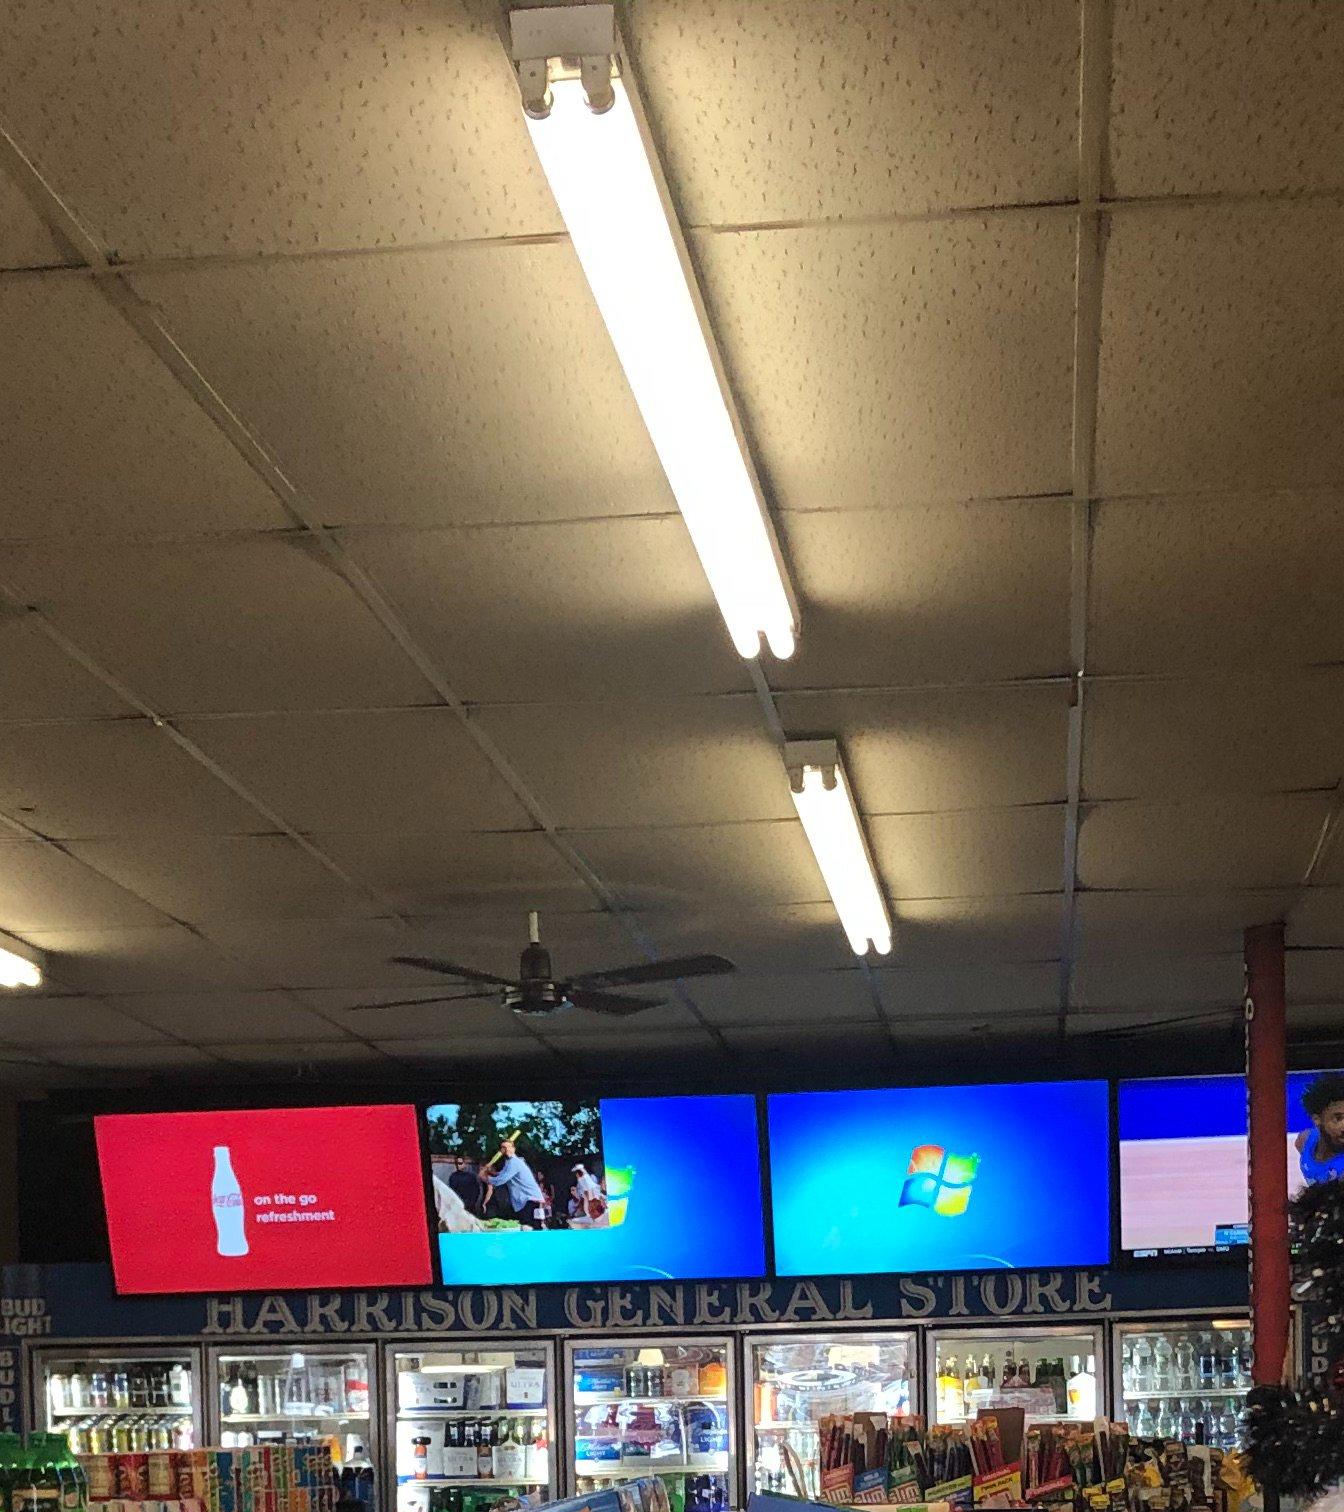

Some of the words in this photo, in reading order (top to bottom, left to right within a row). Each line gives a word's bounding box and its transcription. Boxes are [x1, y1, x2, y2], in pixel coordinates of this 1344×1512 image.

[254, 1195, 272, 1206] on
[274, 1193, 296, 1205] the
[299, 1194, 318, 1207] go
[256, 1210, 335, 1223] refreshment
[0, 1298, 47, 1318] BUD
[201, 1287, 538, 1335] HARRISON
[563, 1279, 874, 1328] GENERAL
[900, 1270, 1114, 1318] STORE
